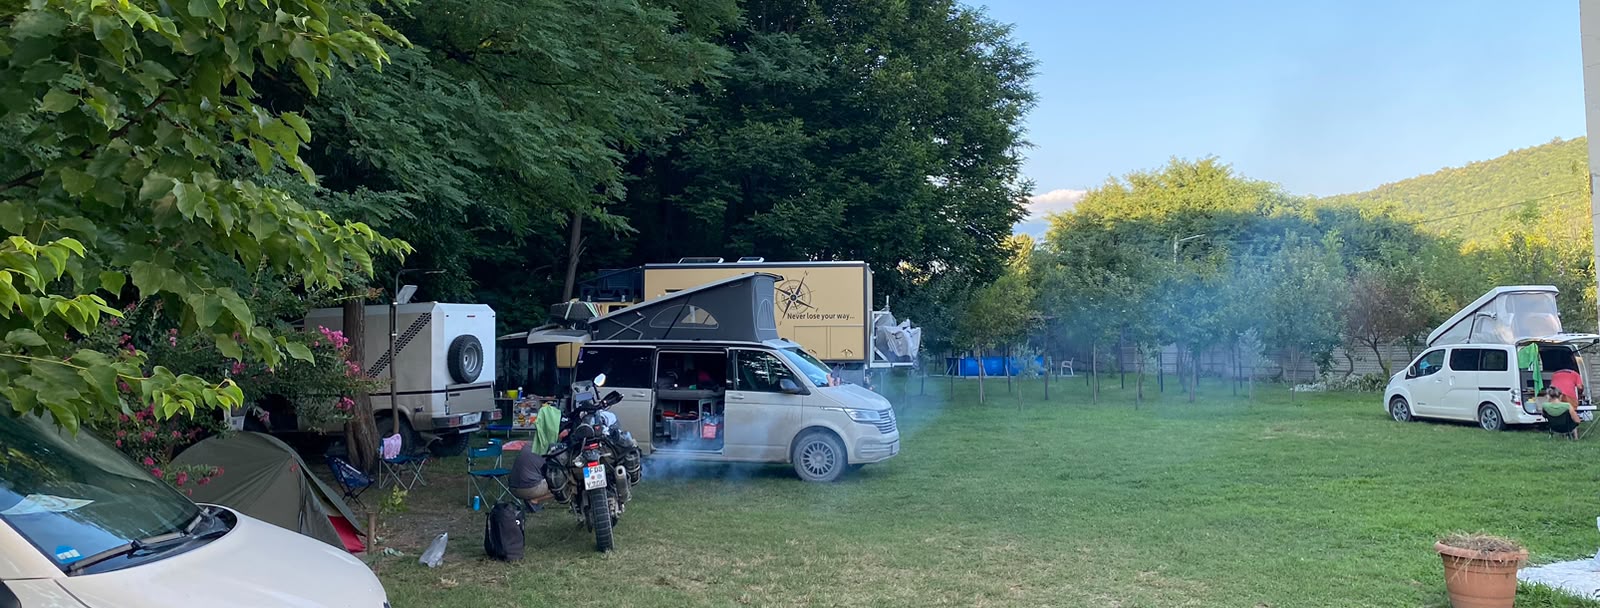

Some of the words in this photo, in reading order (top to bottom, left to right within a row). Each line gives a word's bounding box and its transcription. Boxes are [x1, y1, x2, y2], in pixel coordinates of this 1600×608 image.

[787, 312, 806, 320] Never
[806, 312, 820, 320] lose
[821, 313, 836, 321] your
